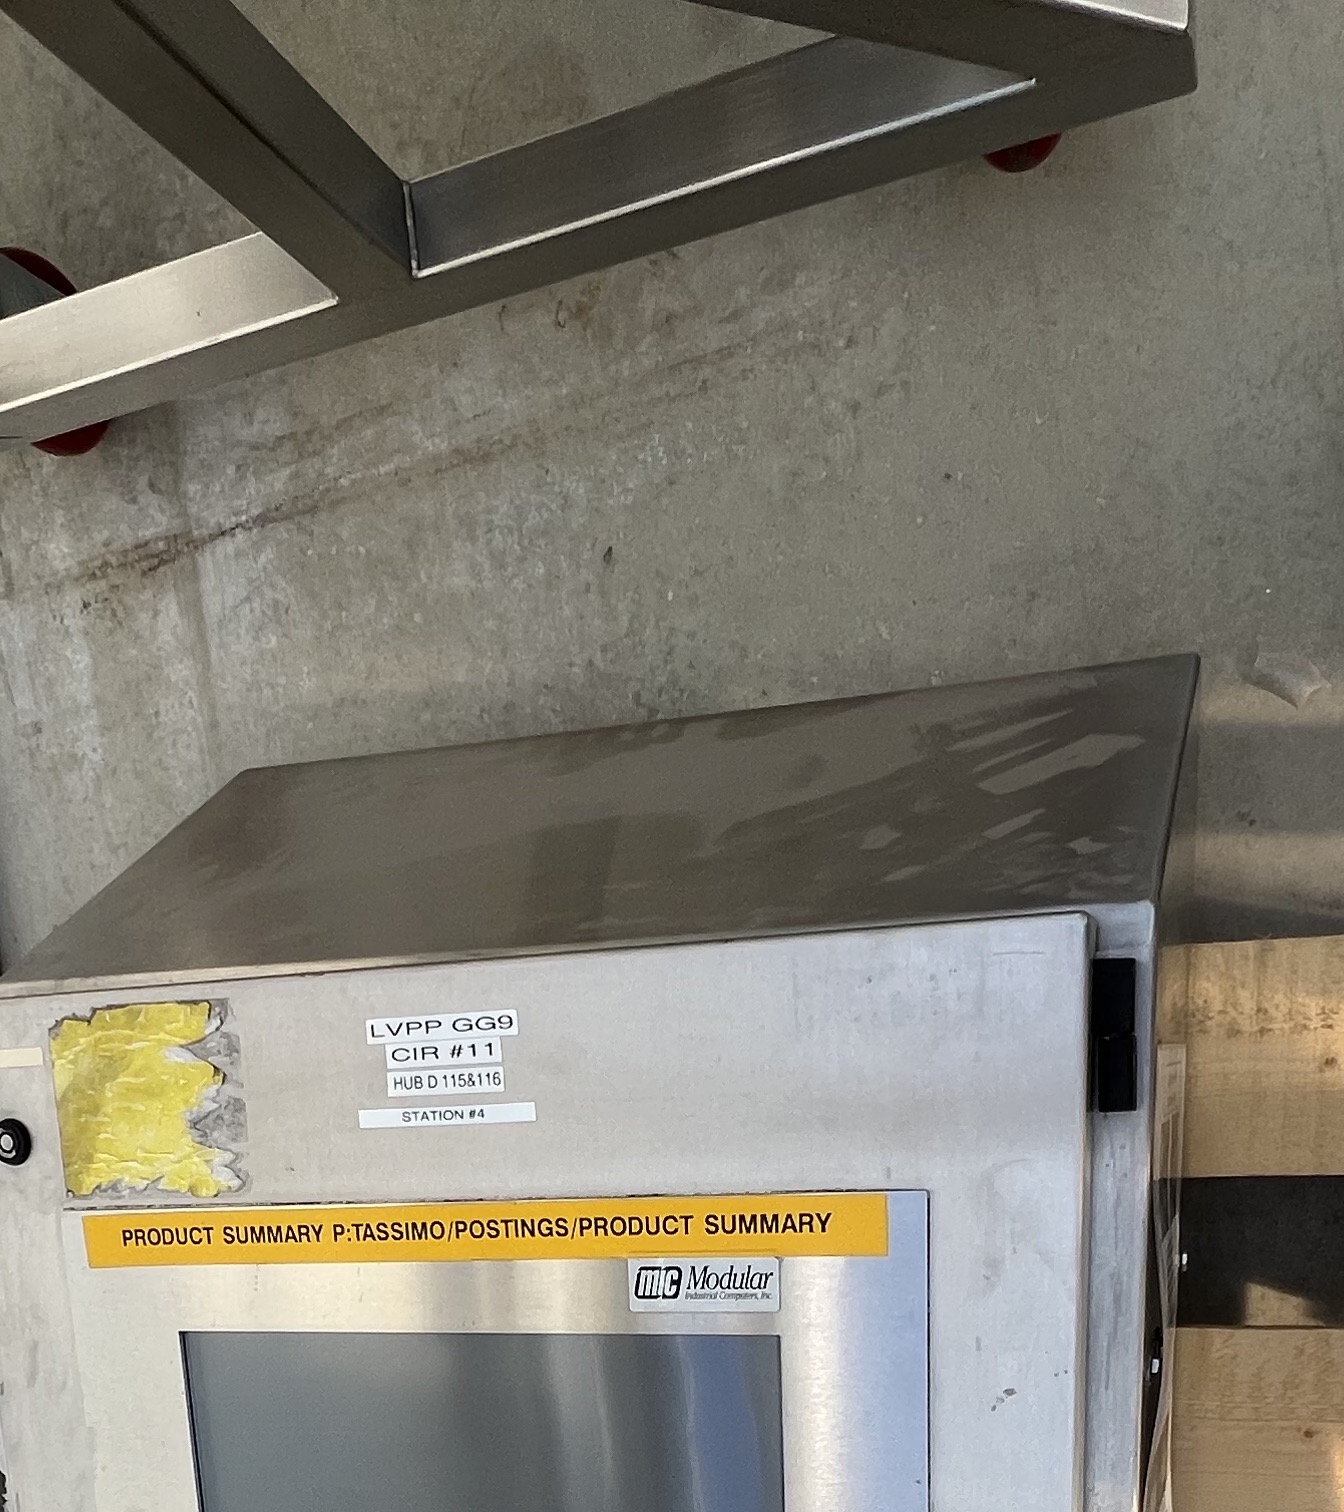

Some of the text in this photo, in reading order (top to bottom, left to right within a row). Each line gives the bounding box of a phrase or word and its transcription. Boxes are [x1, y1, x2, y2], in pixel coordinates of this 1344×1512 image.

[370, 1014, 514, 1039] LVPP GG9
[391, 1042, 494, 1063] CIR #11
[392, 1071, 502, 1091] HUB D 115&116
[401, 1108, 485, 1123] STATION #4
[121, 1226, 215, 1247] PRODUCT
[222, 1224, 324, 1245] SUMMARY
[703, 1212, 833, 1236] SUMMARY
[685, 1264, 774, 1290] Modular
[684, 1290, 718, 1300] Industrial
